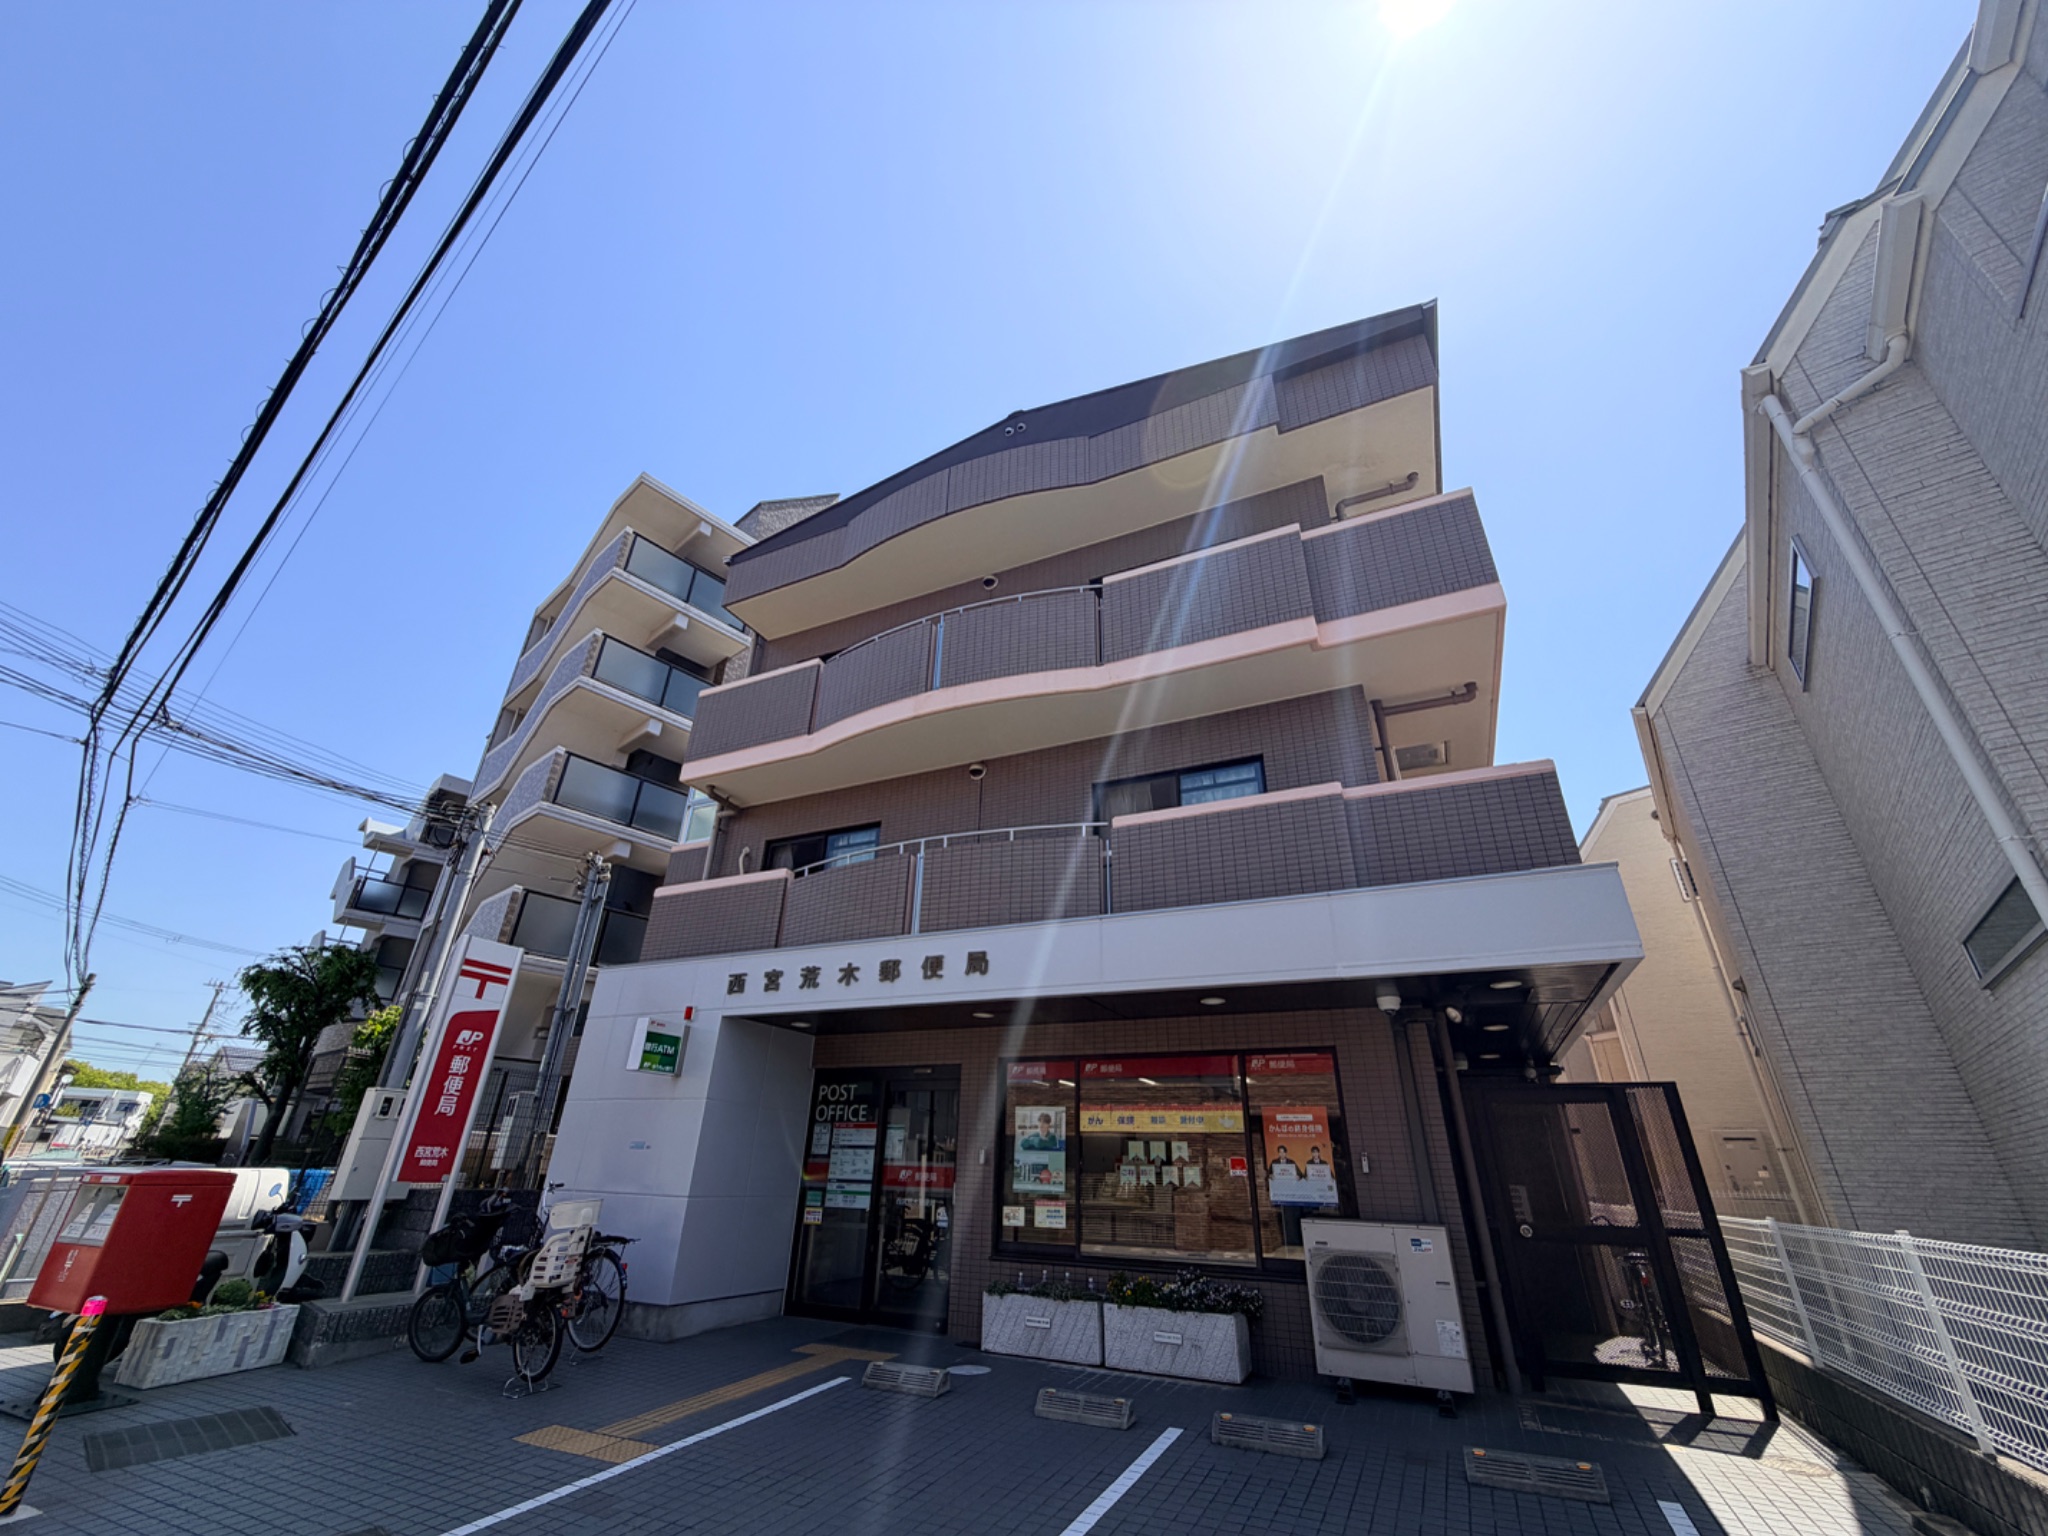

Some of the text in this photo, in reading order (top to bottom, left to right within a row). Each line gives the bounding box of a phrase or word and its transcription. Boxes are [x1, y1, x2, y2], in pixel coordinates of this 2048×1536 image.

[727, 951, 989, 995] 西宮荒木郵便局
[434, 1054, 472, 1117] 郵便局
[819, 1084, 858, 1101] POST
[815, 1104, 868, 1122] OFFICE
